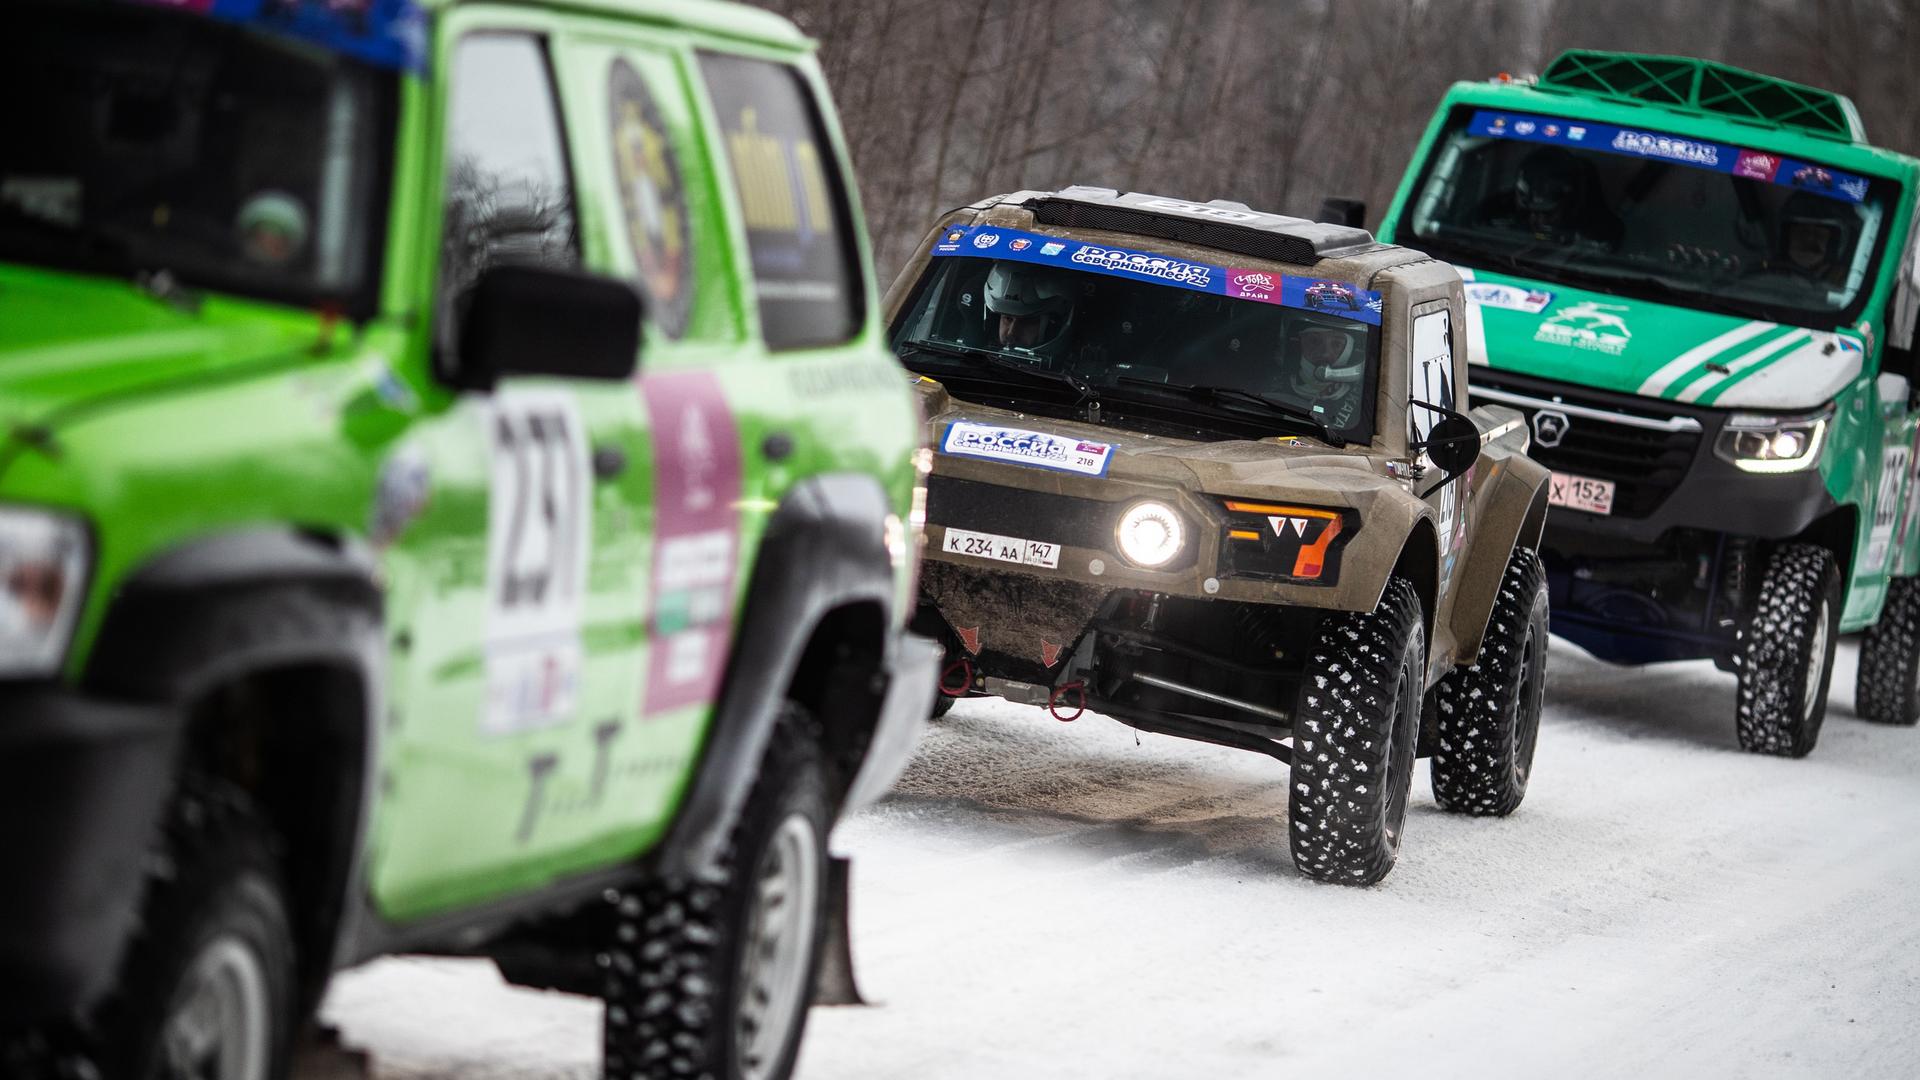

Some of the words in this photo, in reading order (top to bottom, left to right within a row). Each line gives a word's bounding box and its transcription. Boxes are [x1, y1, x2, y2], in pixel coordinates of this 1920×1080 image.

[1085, 246, 1210, 277] РОССИЯ
[1240, 291, 1269, 300] ДРАЙВ
[963, 431, 1066, 456] РОССИЯ
[1076, 457, 1095, 467] 218
[1573, 481, 1606, 502] 152
[950, 537, 960, 551] К
[965, 538, 994, 556] 234
[1000, 546, 1018, 560] АА
[1030, 543, 1052, 558] 147
